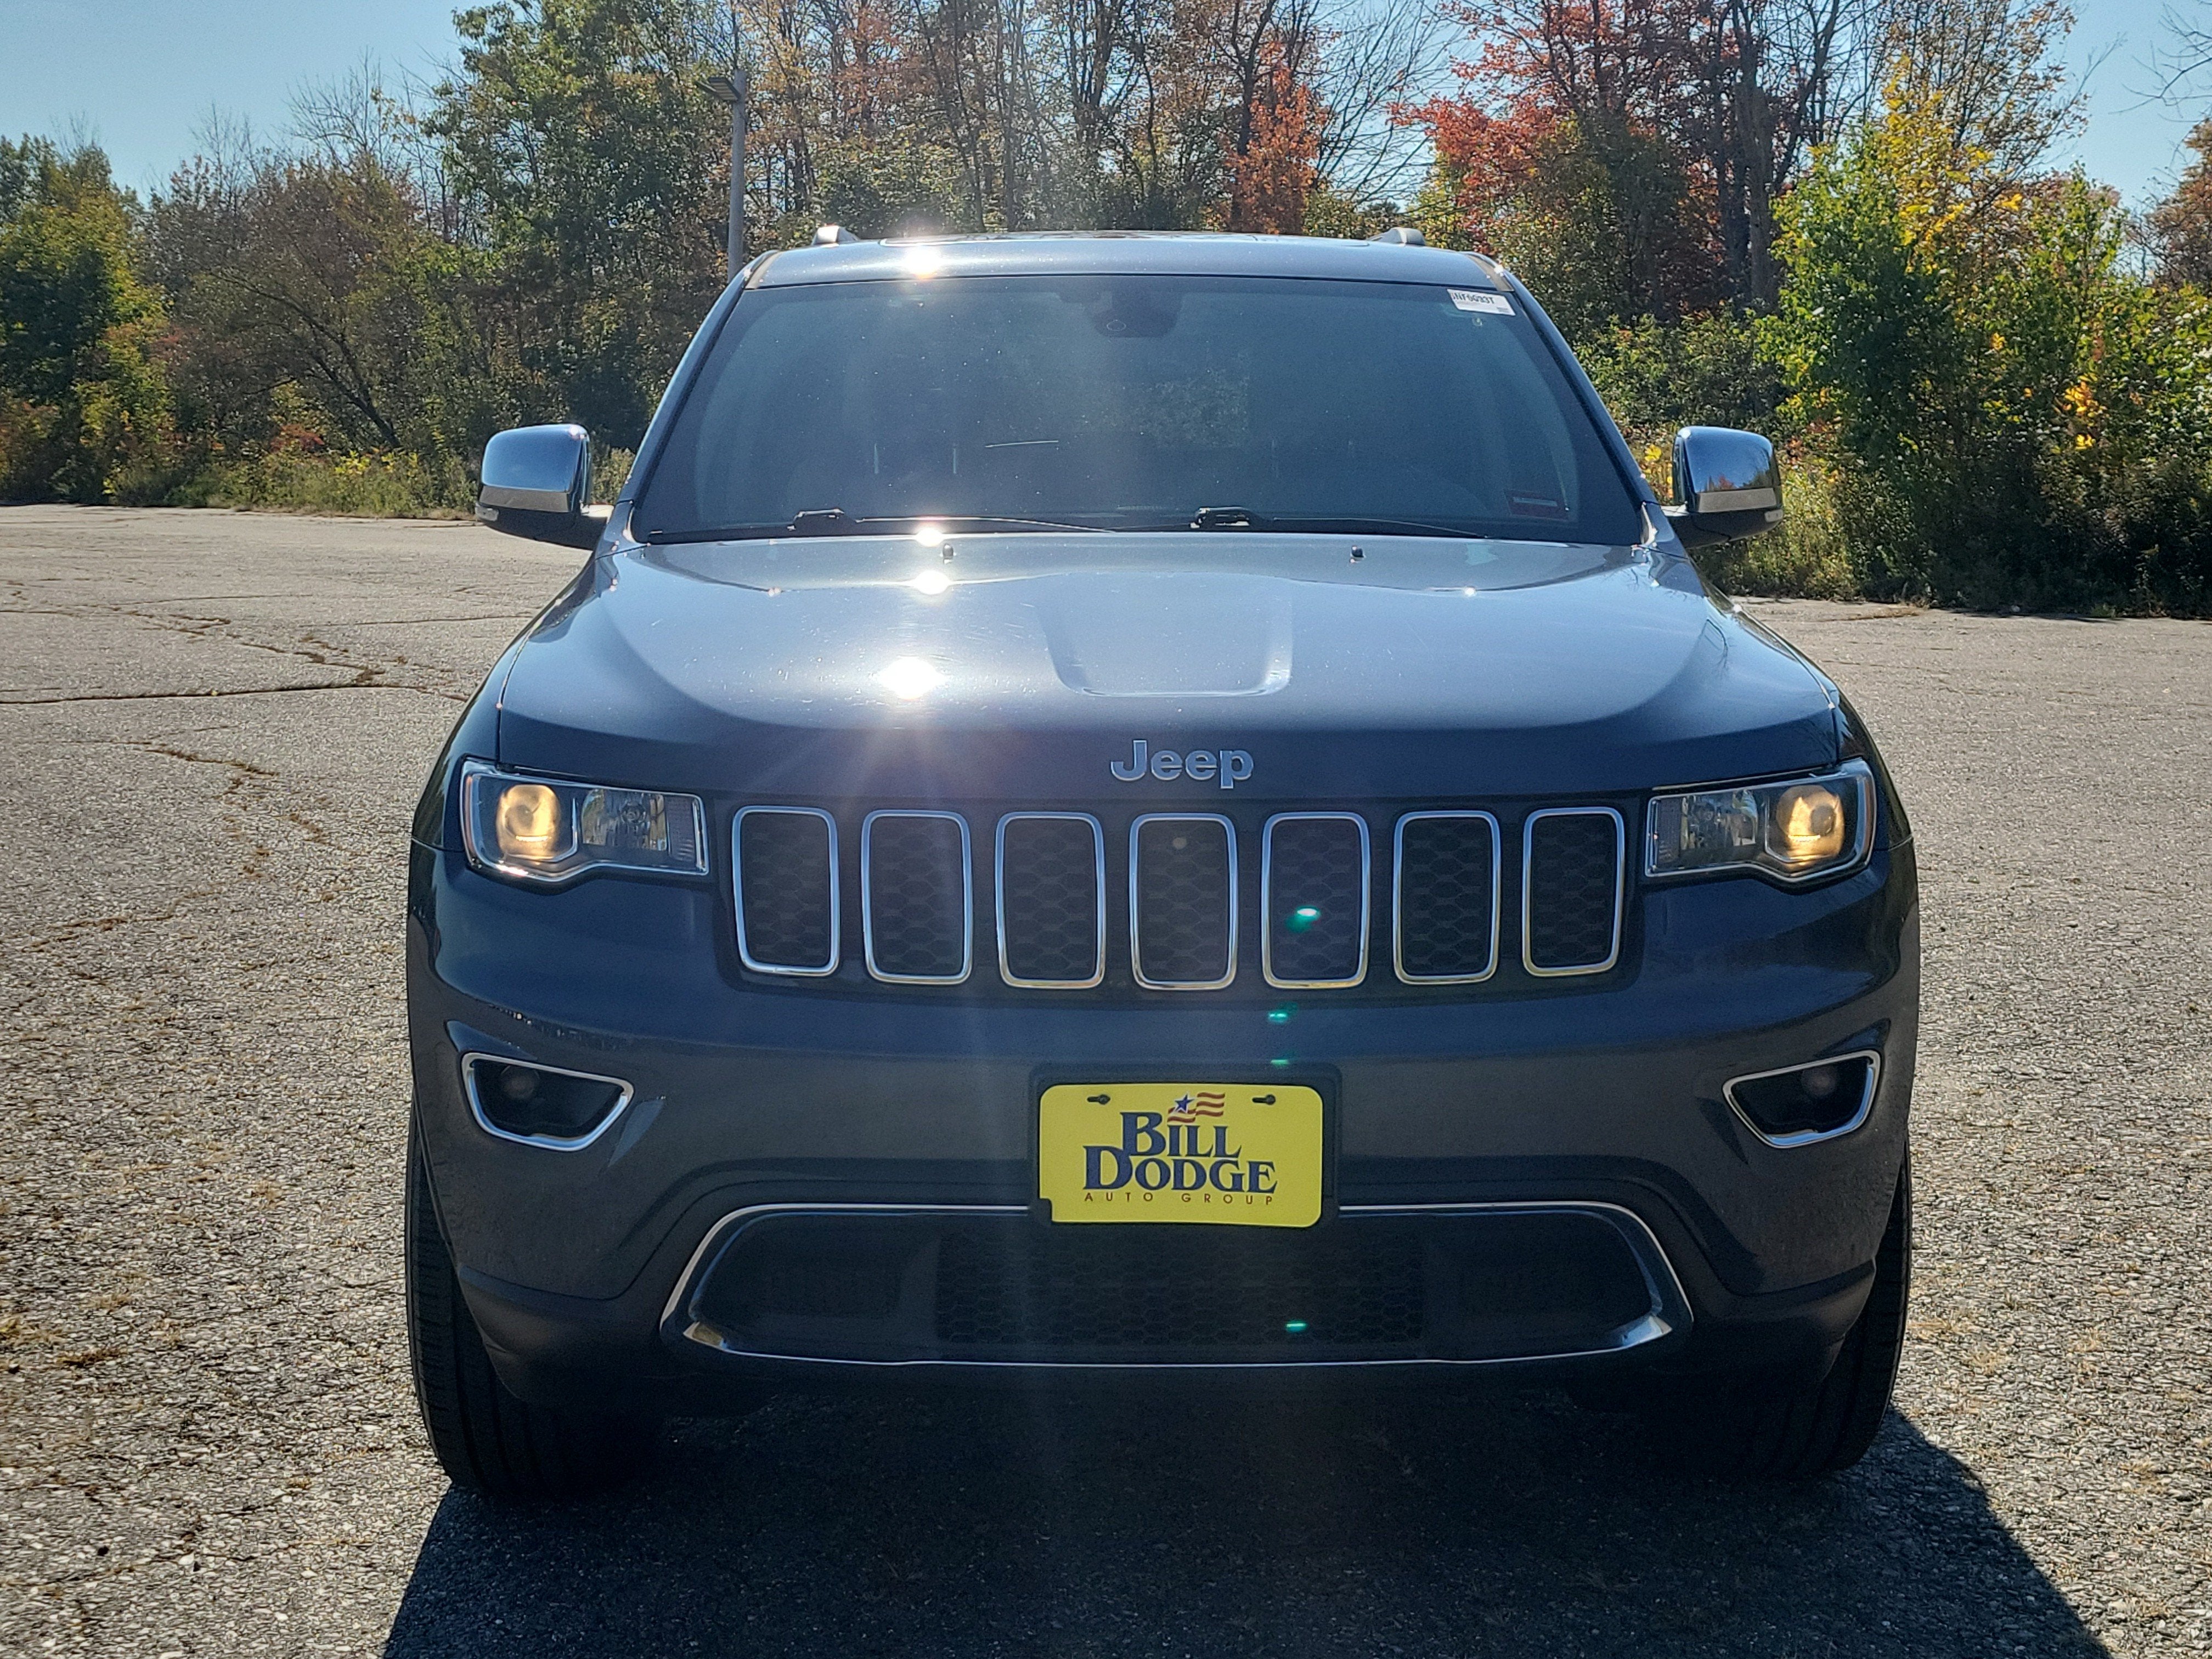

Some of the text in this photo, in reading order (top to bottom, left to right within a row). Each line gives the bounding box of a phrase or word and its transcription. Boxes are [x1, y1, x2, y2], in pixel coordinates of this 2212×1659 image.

[1110, 740, 1254, 789] Jeep
[1119, 1111, 1242, 1157] BILL
[1082, 1145, 1278, 1193] DODGE
[1084, 1192, 1273, 1205] AUTO GROUP
